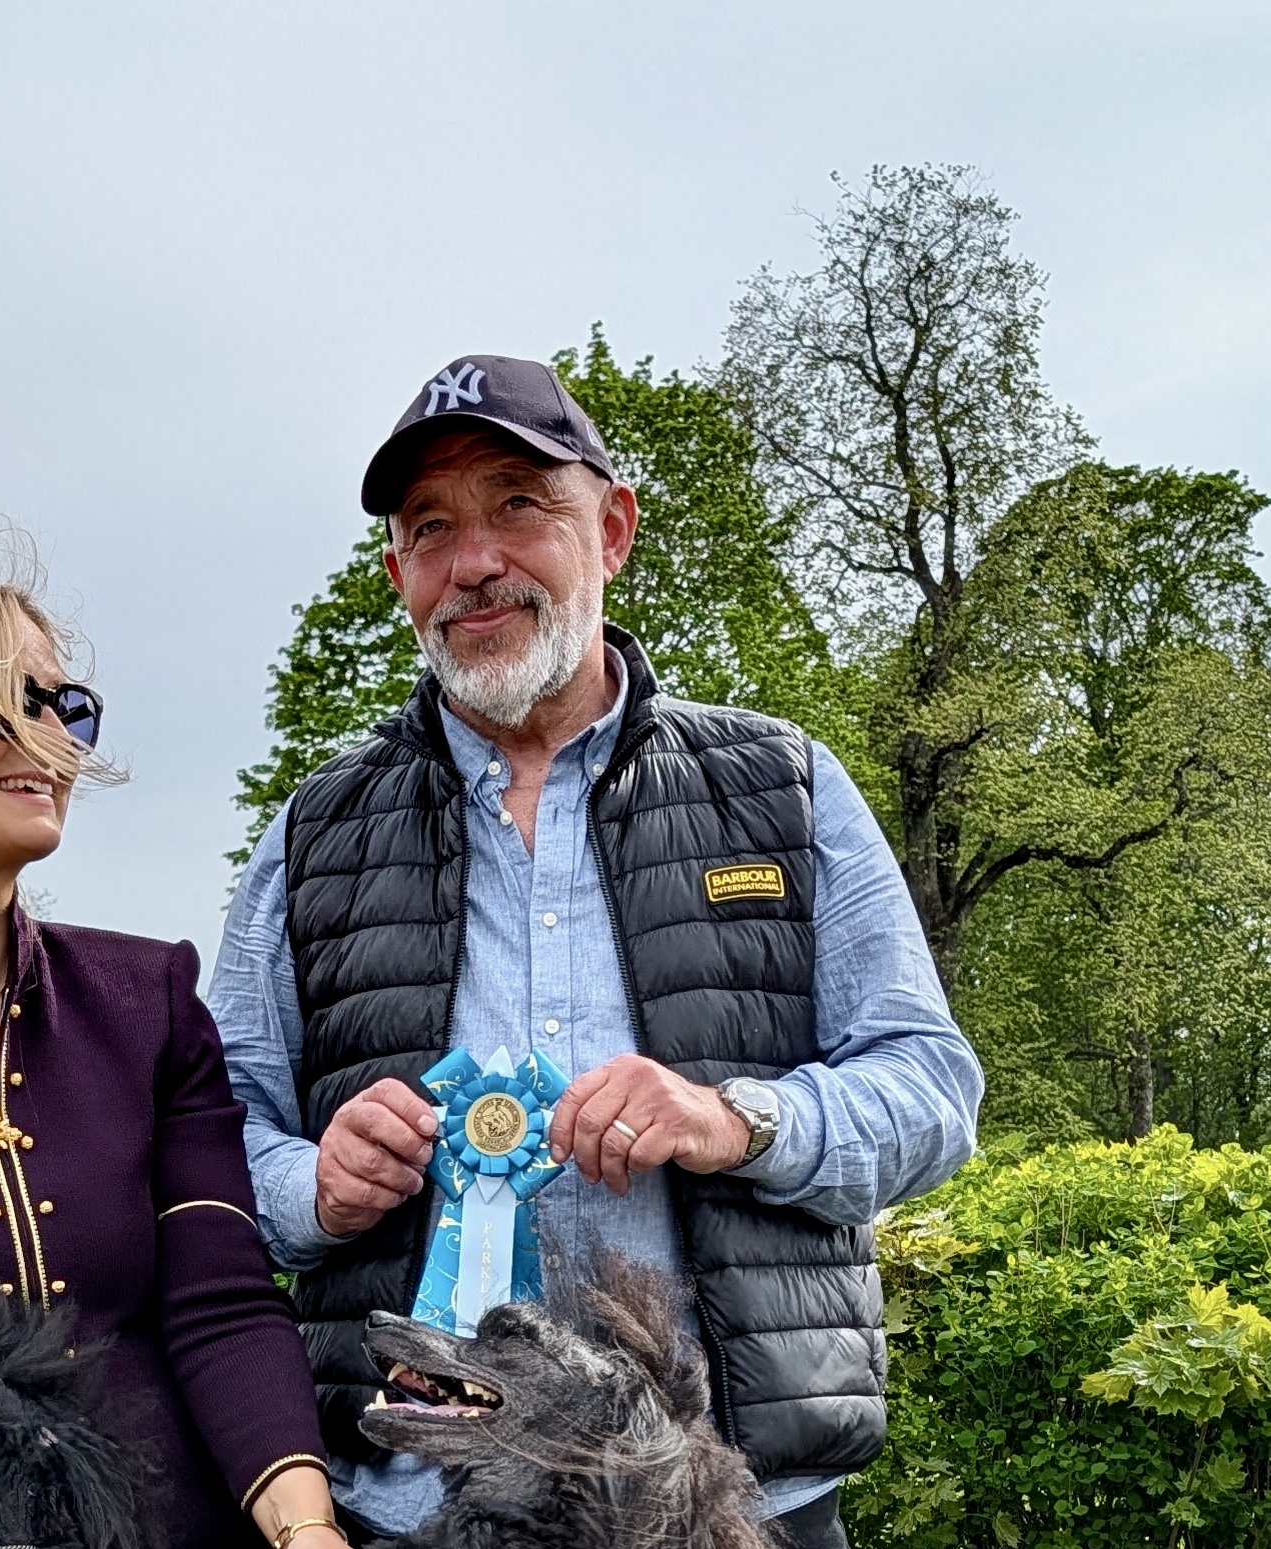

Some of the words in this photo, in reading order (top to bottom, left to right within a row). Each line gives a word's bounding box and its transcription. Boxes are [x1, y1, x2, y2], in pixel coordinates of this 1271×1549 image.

[424, 363, 485, 415] NY
[711, 870, 777, 887] BARBOUR
[712, 883, 780, 895] INTERNATIONAL
